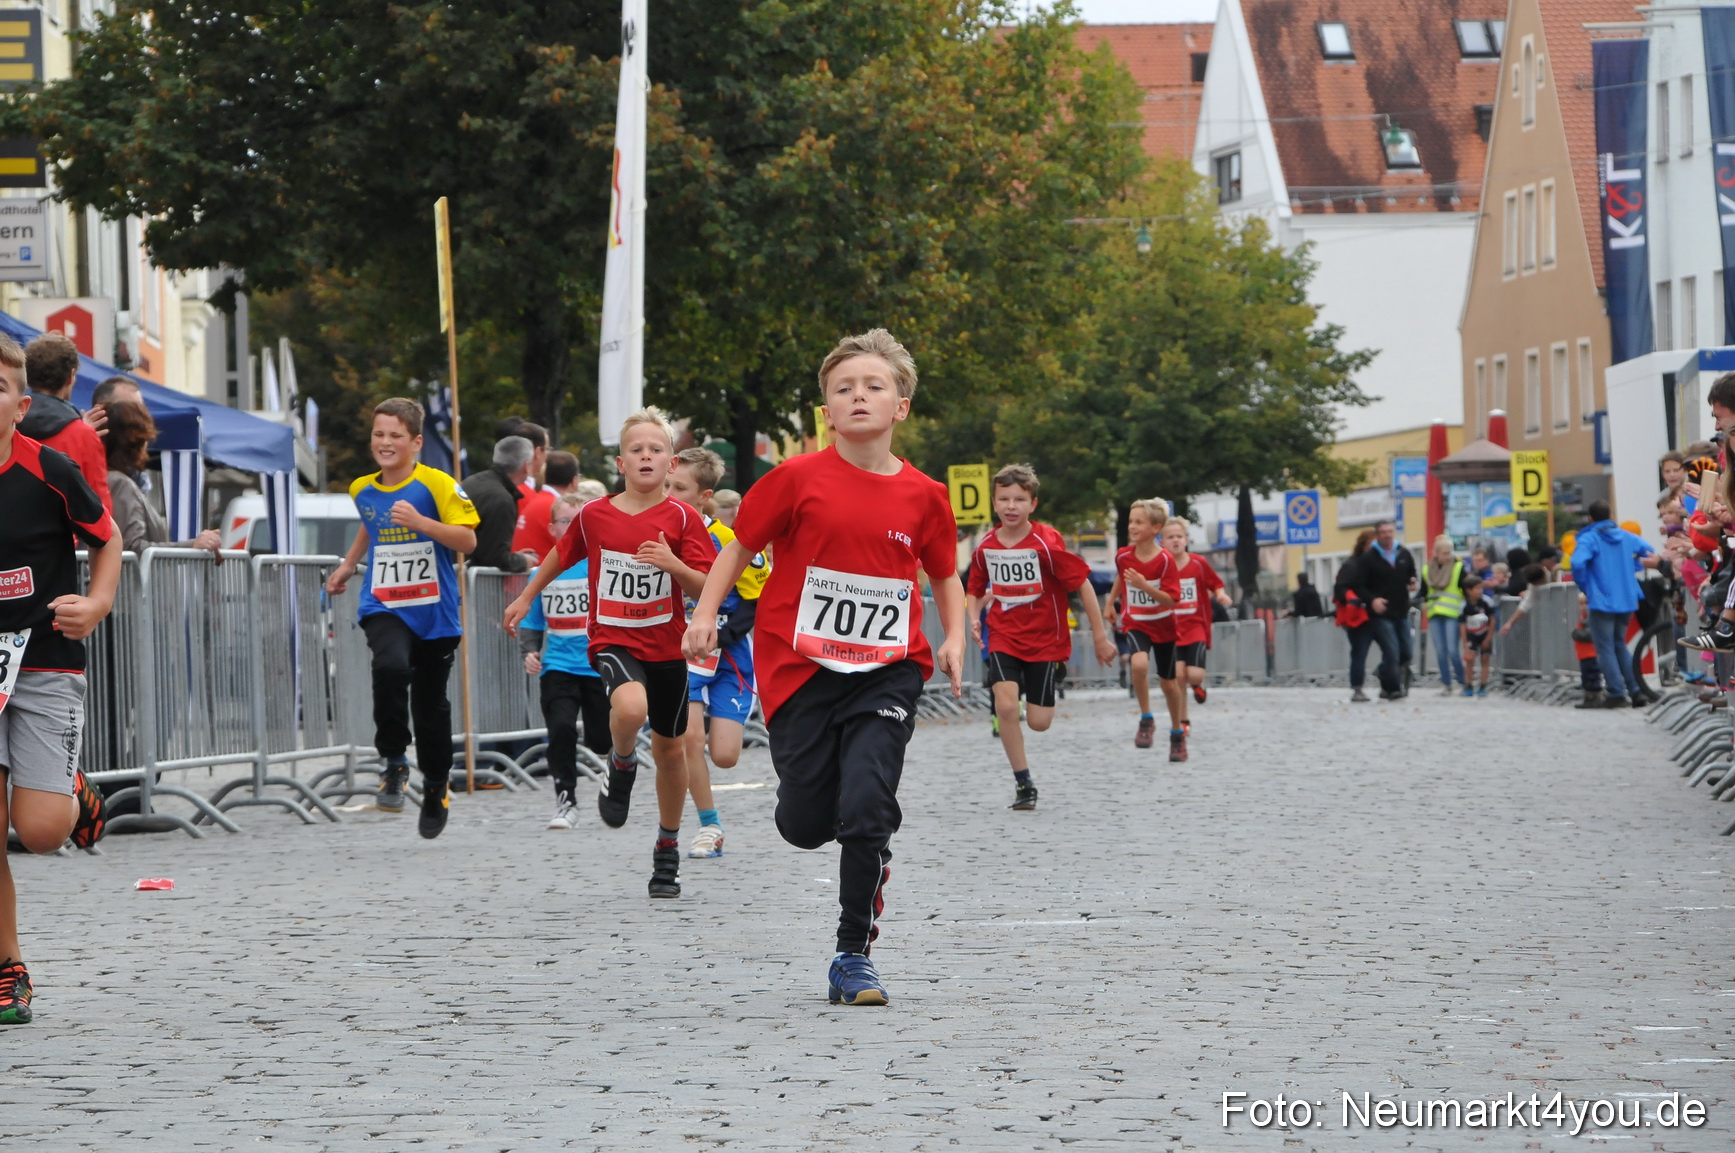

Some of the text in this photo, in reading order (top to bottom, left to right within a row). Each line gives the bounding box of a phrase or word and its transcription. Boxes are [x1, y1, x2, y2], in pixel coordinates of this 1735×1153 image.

[1516, 453, 1547, 464] Block
[1523, 469, 1542, 496] D
[961, 484, 979, 510] D
[1288, 528, 1319, 540] TAXI
[378, 558, 430, 583] 7172
[990, 562, 1035, 582] 7098
[14, 586, 29, 594] dog
[389, 587, 420, 598] Marcel
[606, 569, 664, 599] 7057
[807, 577, 894, 599] PARTL Neumarkt
[543, 593, 589, 614] 7238
[623, 606, 647, 617] Luca
[813, 593, 900, 641] 7072
[822, 643, 879, 662] Michael
